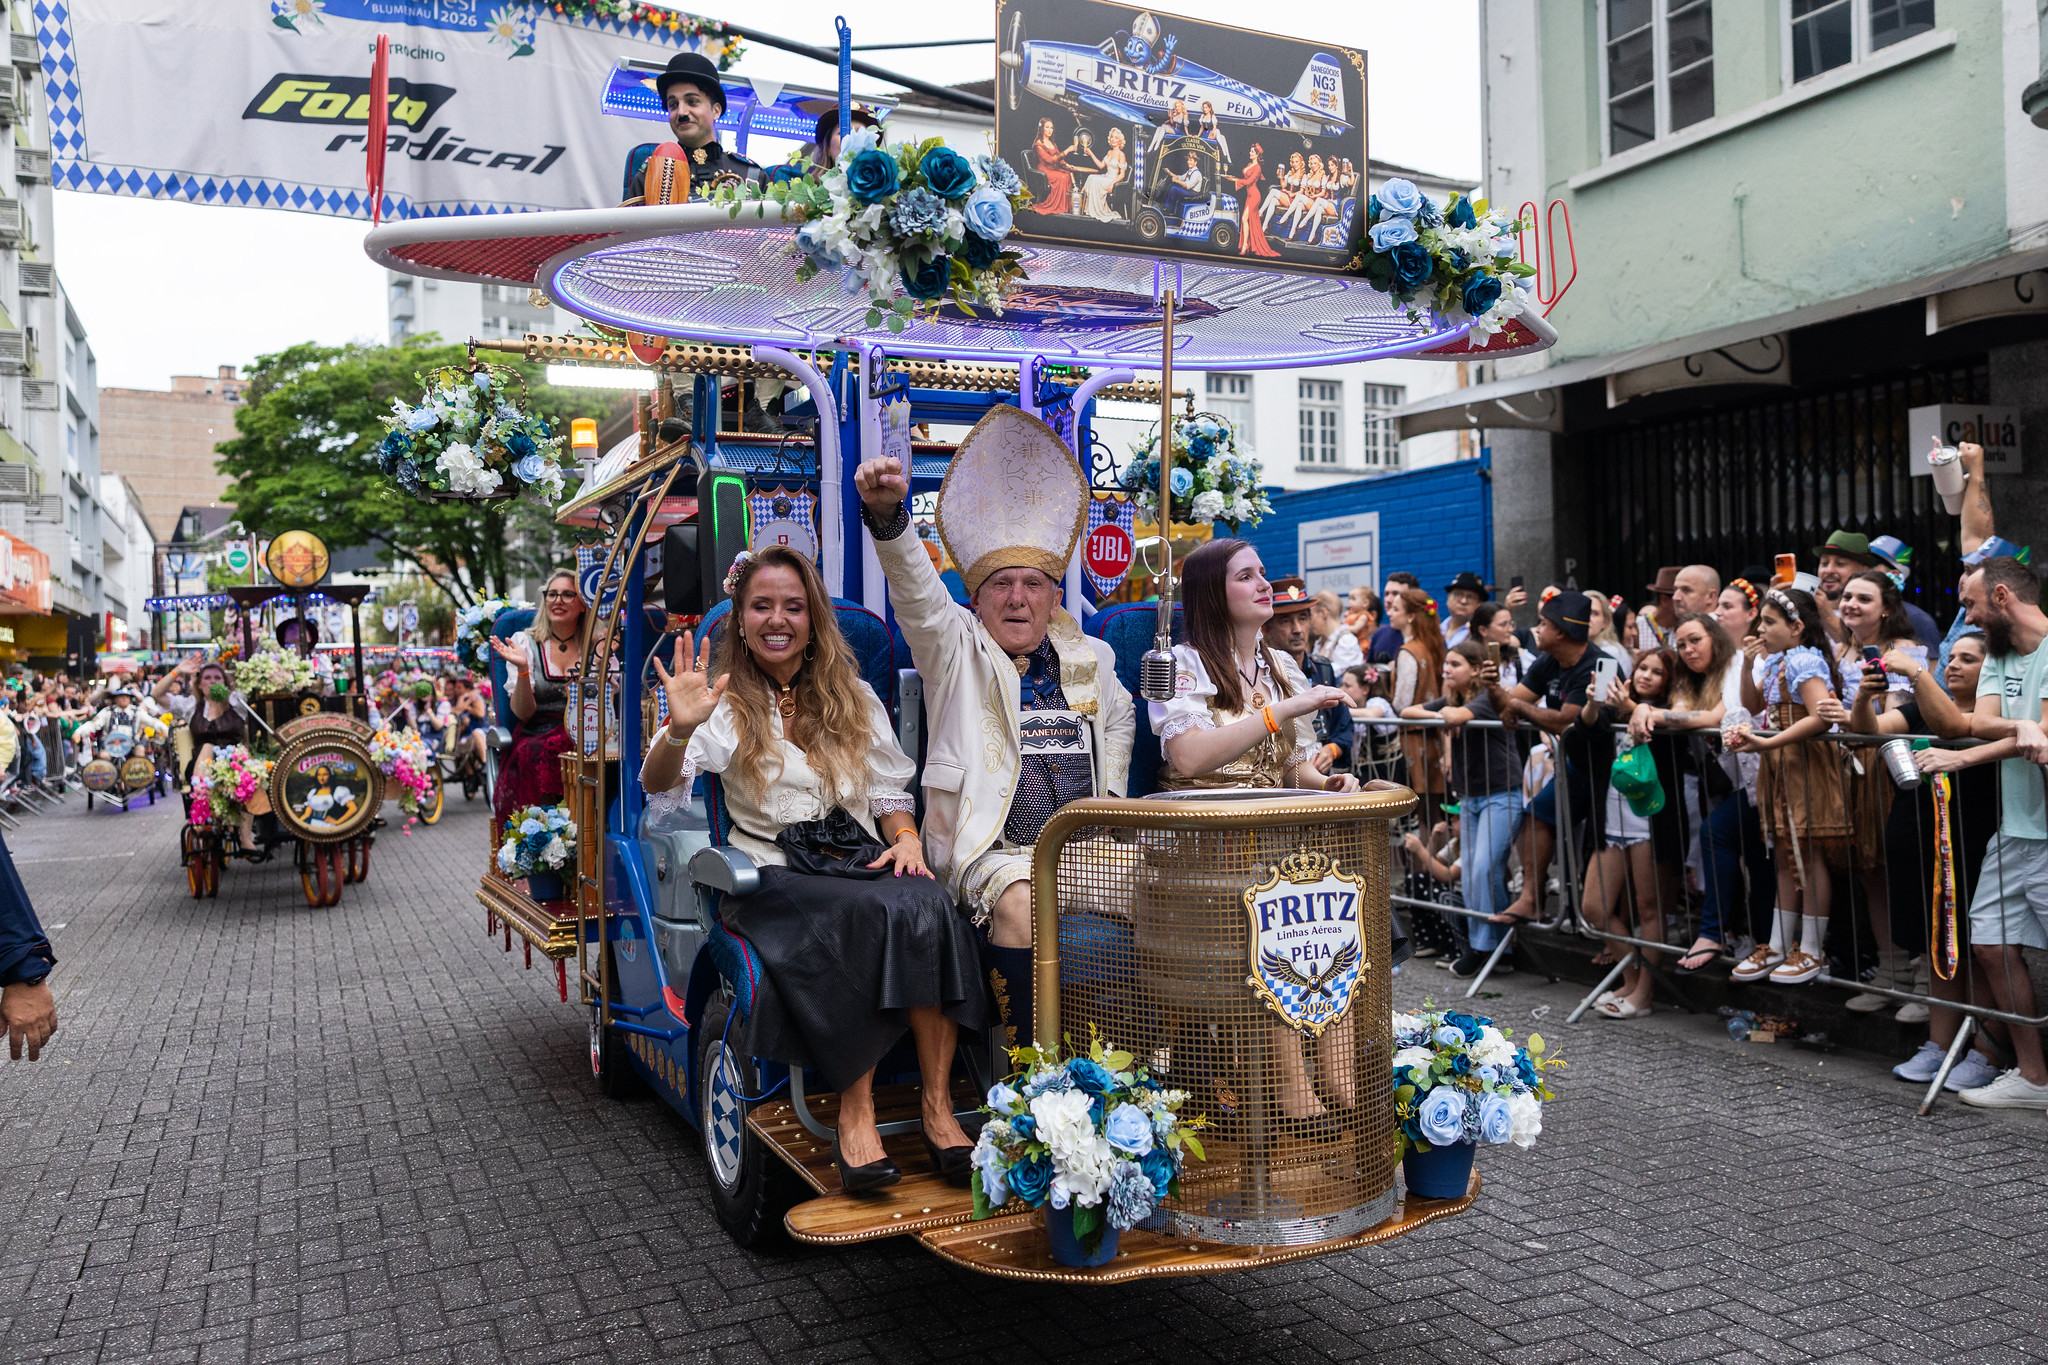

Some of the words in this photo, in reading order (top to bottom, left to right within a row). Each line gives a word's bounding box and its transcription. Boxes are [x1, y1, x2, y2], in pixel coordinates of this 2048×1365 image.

[371, 4, 431, 19] BLUMENAU
[440, 10, 478, 27] 2026
[368, 43, 445, 62] PTROCÍNIO
[1095, 61, 1187, 102] FRITZ
[1313, 73, 1336, 91] NG3
[1101, 84, 1135, 100] Linhas
[1136, 93, 1169, 107] Aéreas
[1227, 101, 1254, 117] PÉIA
[1190, 207, 1210, 219] BISTRÔ
[1946, 413, 2017, 447] caluá
[1092, 535, 1128, 562] JBL
[1258, 891, 1357, 933] FRITZ
[1277, 928, 1309, 941] Linhas
[1311, 925, 1343, 936] Aéreas
[1291, 941, 1332, 963] PÉIA
[1298, 1000, 1334, 1017] 2026
